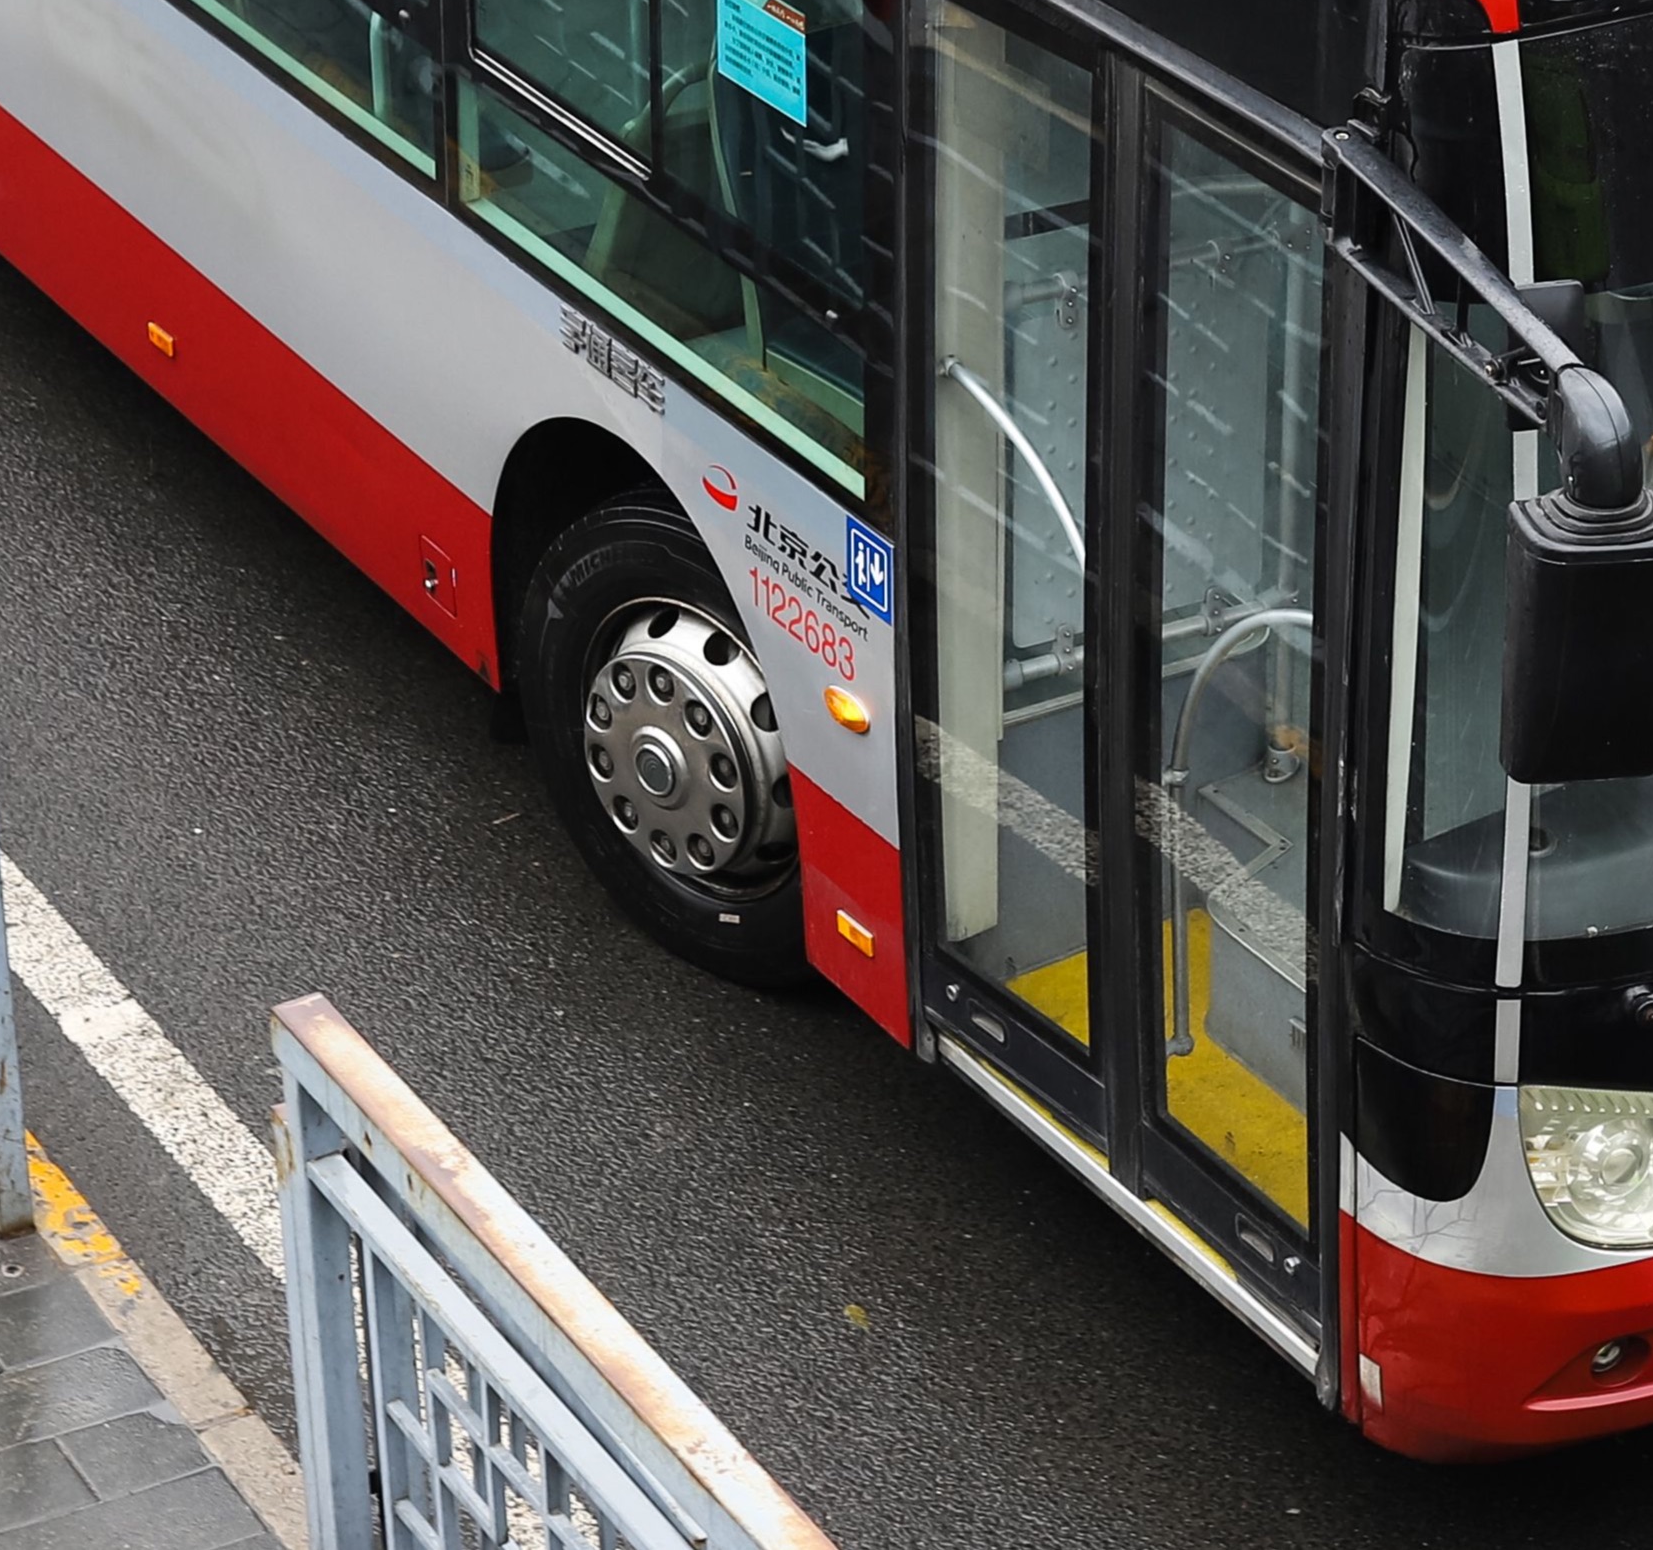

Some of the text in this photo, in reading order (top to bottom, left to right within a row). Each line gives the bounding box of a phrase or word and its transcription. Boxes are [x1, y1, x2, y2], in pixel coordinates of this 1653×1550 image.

[744, 534, 870, 643] Beijing Public Transport
[749, 566, 856, 681] 1122683
